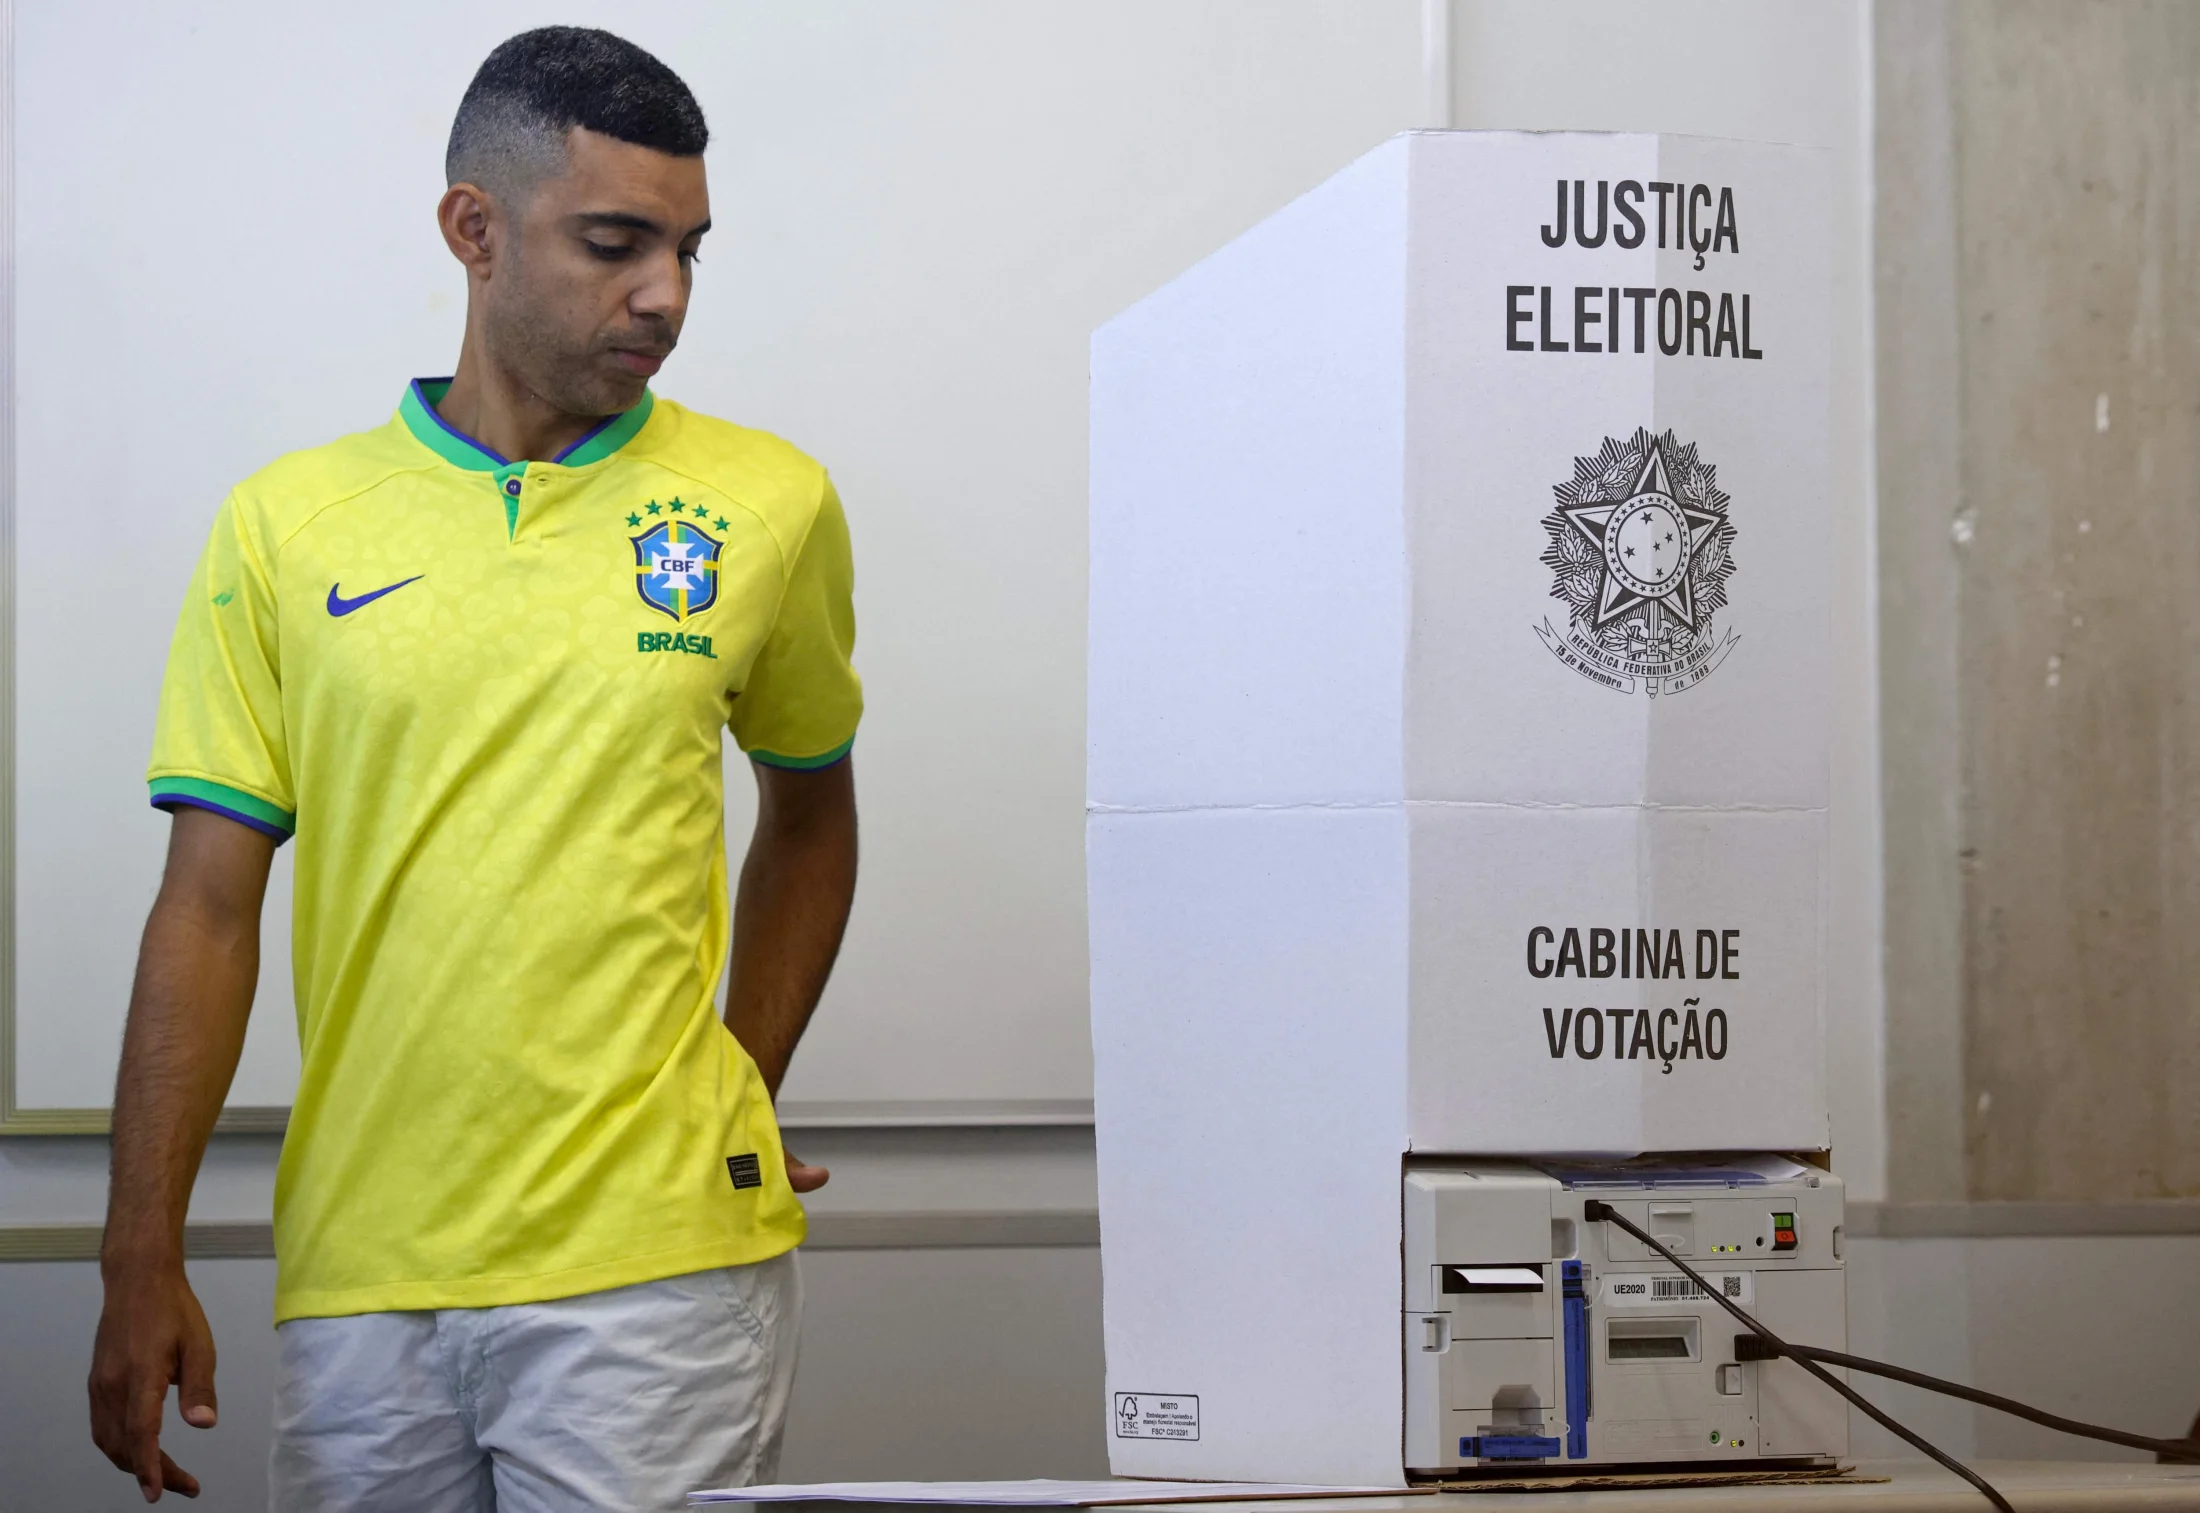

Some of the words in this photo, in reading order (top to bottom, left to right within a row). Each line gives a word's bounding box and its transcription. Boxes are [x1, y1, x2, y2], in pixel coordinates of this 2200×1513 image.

[1540, 179, 1739, 272] JUSTIÇA
[1506, 285, 1763, 360] ELEITORAL
[660, 559, 695, 573] CBF
[637, 632, 718, 660] BRASIL
[1623, 662, 1672, 676] FEDERATIVA
[1674, 659, 1685, 672] DO
[1686, 642, 1711, 666] BRASIL
[1555, 644, 1567, 656] 15
[1565, 654, 1577, 666] de
[1577, 661, 1622, 688] Novembro
[1674, 680, 1685, 690] de
[1690, 664, 1710, 683] 1889
[1527, 926, 1686, 980] CABINA
[1695, 929, 1740, 980] DE
[1542, 997, 1728, 1075] VOTAÇÃO
[1614, 1284, 1646, 1295] UE2020
[1160, 1402, 1178, 1410] MISTO
[1122, 1421, 1139, 1430] FSC
